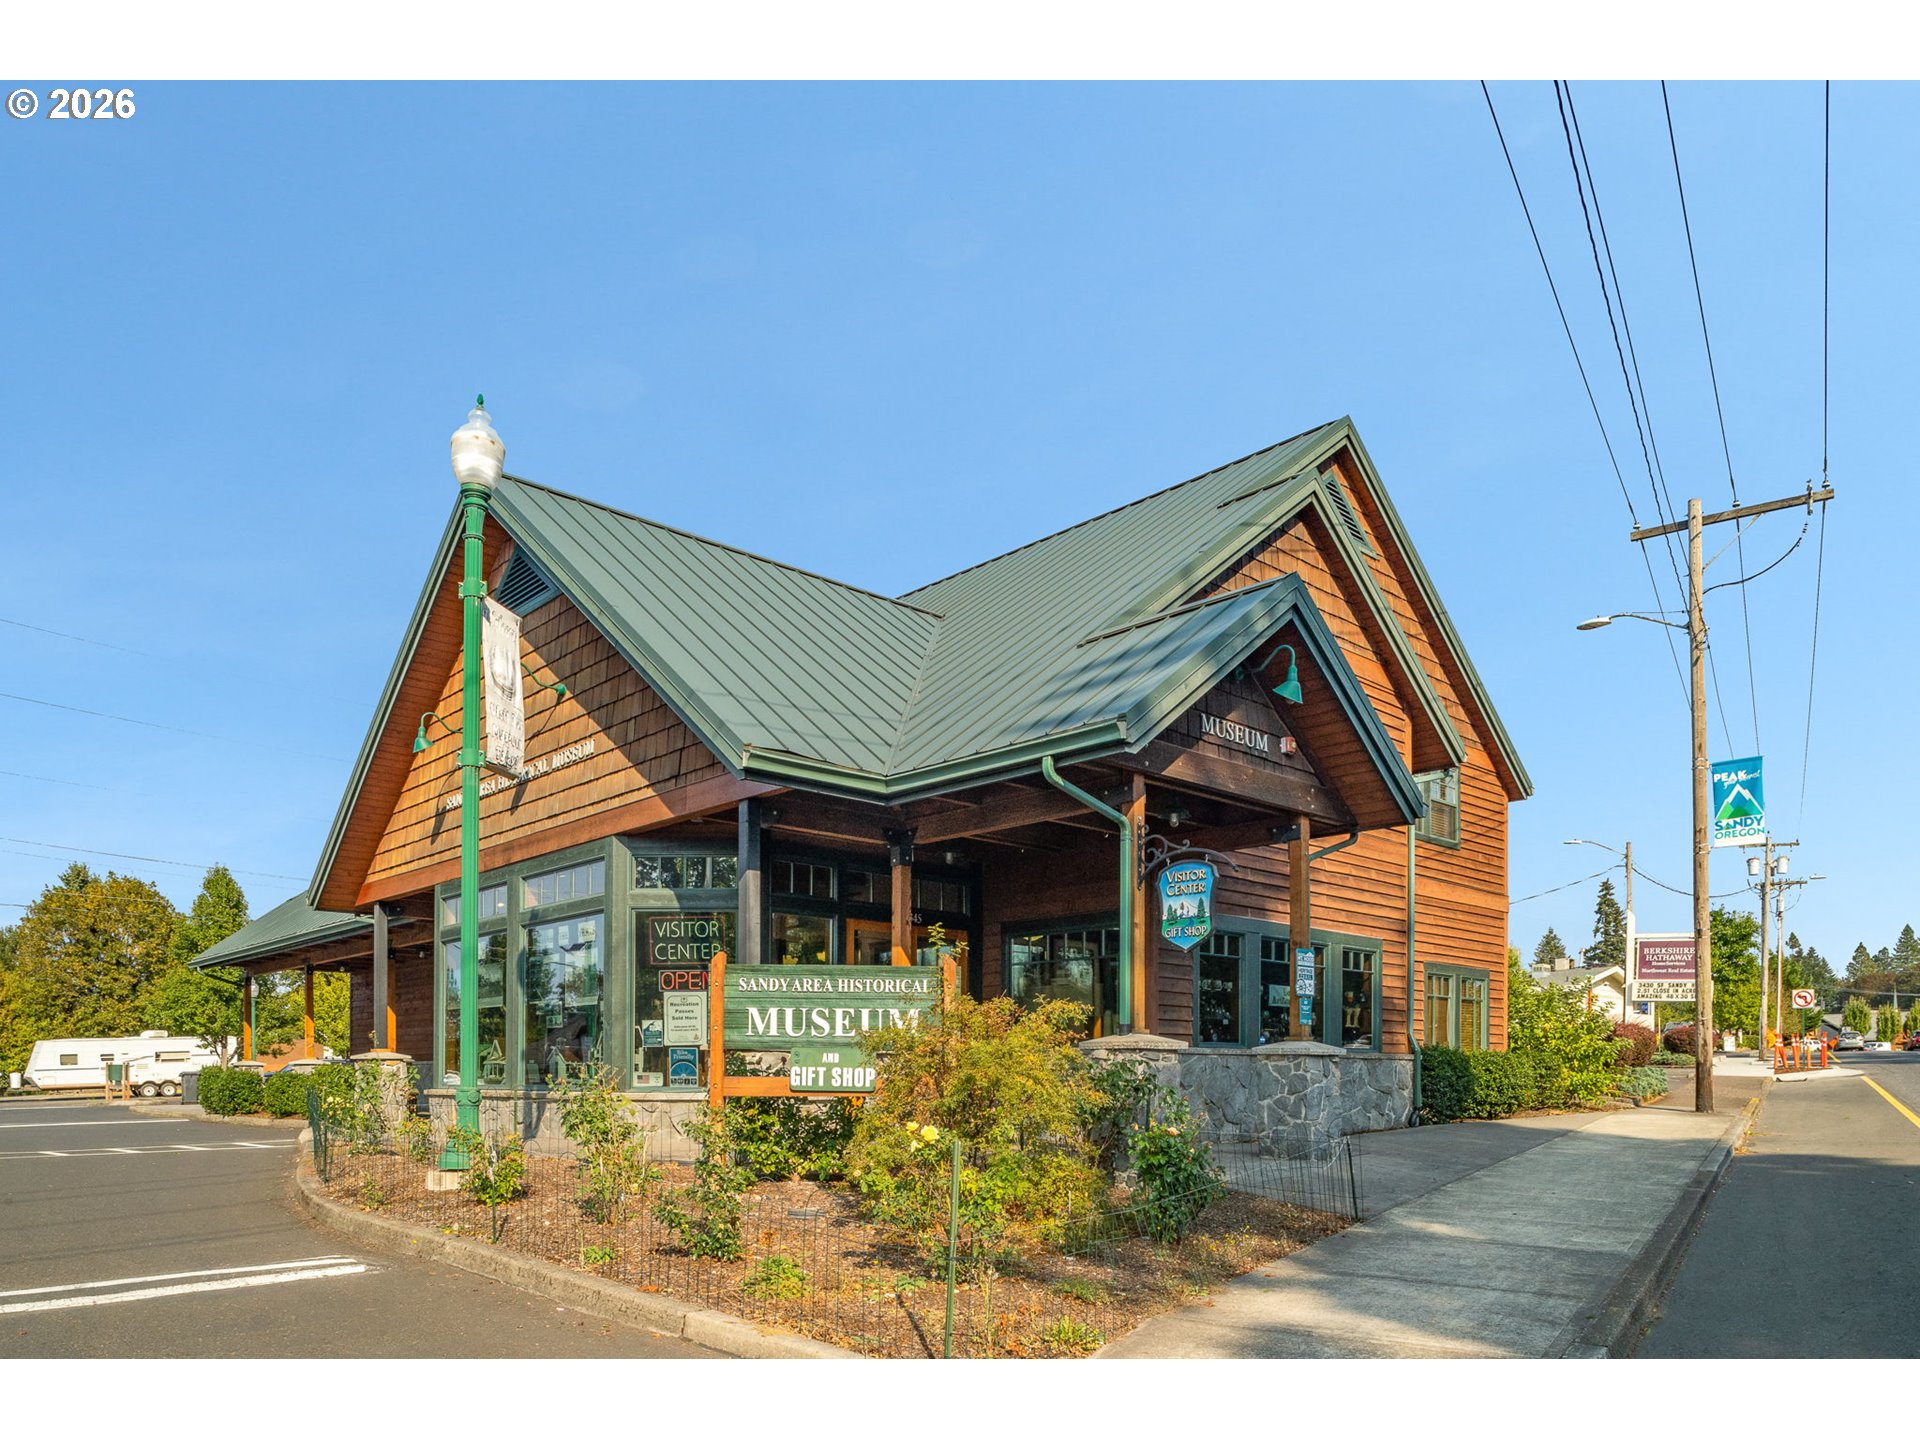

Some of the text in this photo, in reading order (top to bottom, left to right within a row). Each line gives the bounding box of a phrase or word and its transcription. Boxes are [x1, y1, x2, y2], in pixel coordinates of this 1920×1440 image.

[1201, 713, 1269, 752] MUSEUM
[553, 740, 595, 769] MUSEUM
[1713, 770, 1746, 783] PEAK
[1715, 816, 1763, 831] SANDY
[1714, 827, 1765, 839] OREGON
[1166, 869, 1206, 883] VISITOR
[1166, 883, 1206, 896] CENTER
[654, 920, 719, 938] VISITOR
[1165, 925, 1207, 938] GIFT SHOP
[654, 943, 721, 960] CENTER
[739, 977, 929, 993] SANDY AREA HISTORICAL
[745, 1007, 921, 1037] MUSEUM
[822, 1053, 840, 1063] AND
[790, 1066, 876, 1087] GIFT SHOP
